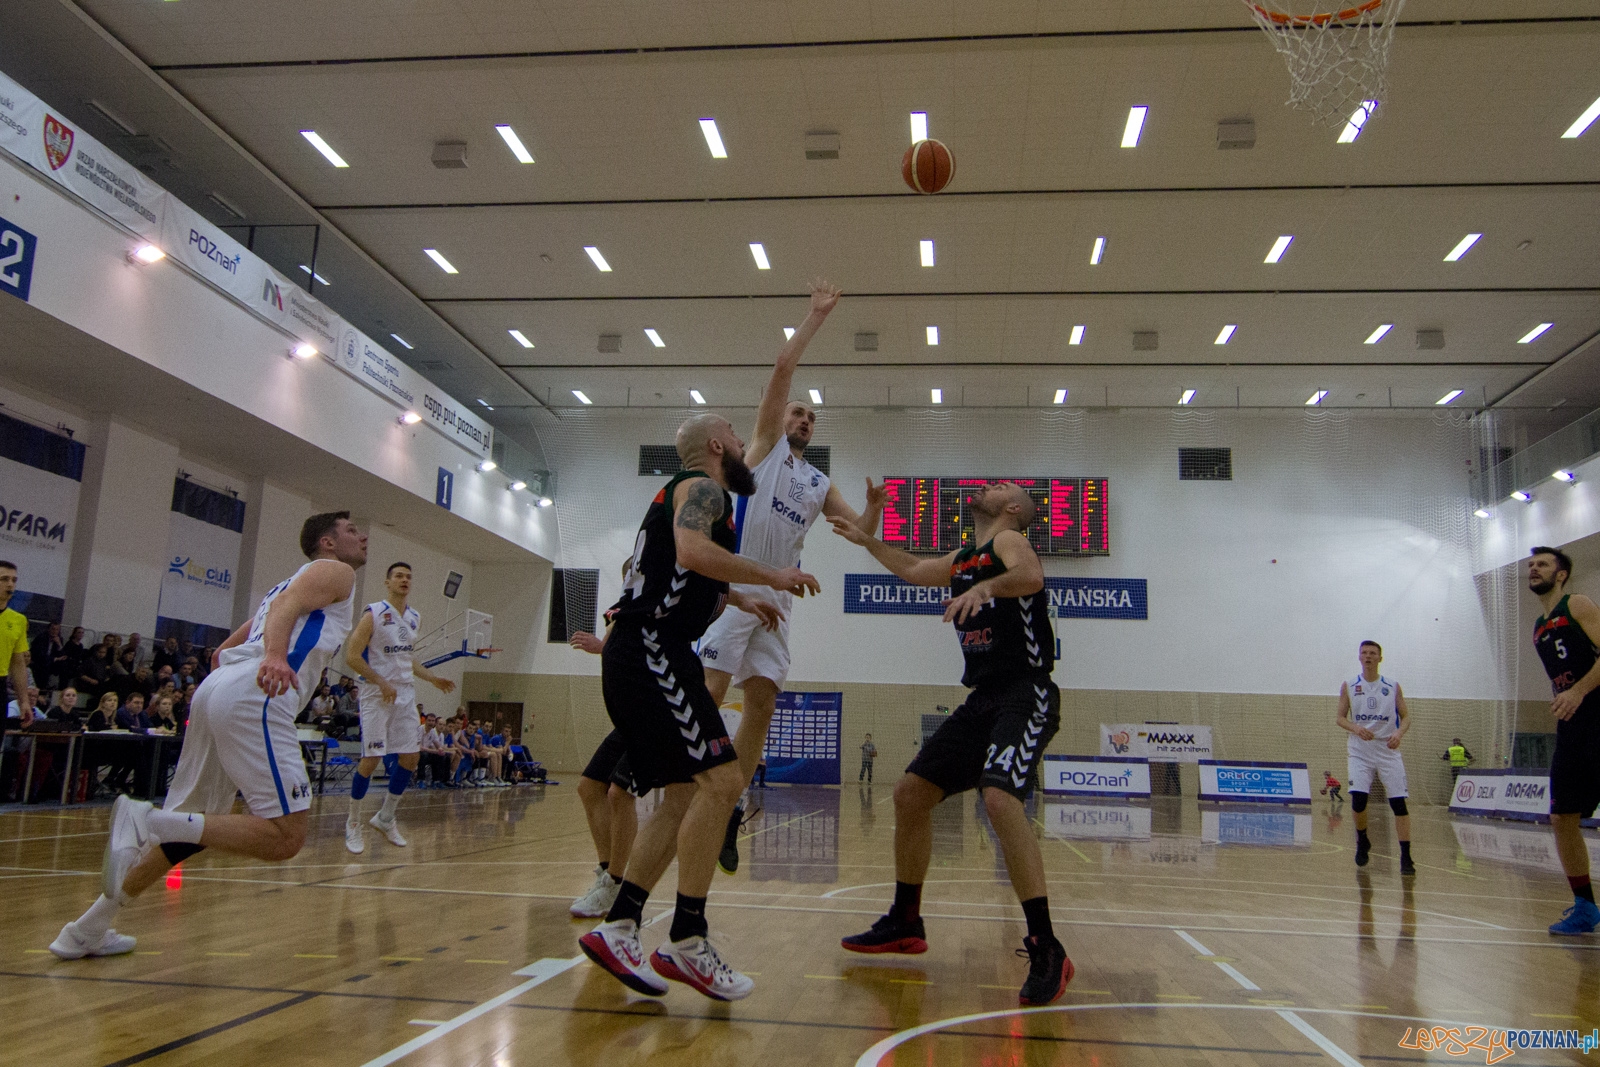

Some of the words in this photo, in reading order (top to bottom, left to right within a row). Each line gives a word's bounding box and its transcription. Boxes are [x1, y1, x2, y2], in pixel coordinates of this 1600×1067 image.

[0, 229, 25, 288] 2
[424, 394, 490, 451] cspp.put.poznan.pl
[442, 474, 449, 504] 1
[788, 477, 806, 503] 12
[398, 626, 408, 641] 2
[383, 644, 414, 654] BIOFAR
[703, 647, 718, 661] PBG
[1554, 638, 1568, 660] 5
[1147, 732, 1195, 745] MAXXX
[1156, 744, 1168, 753] hit
[1184, 745, 1210, 754] hitem
[983, 743, 1016, 772] 24
[1476, 786, 1497, 799] DELIK
[1505, 783, 1546, 799] BIOFARM
